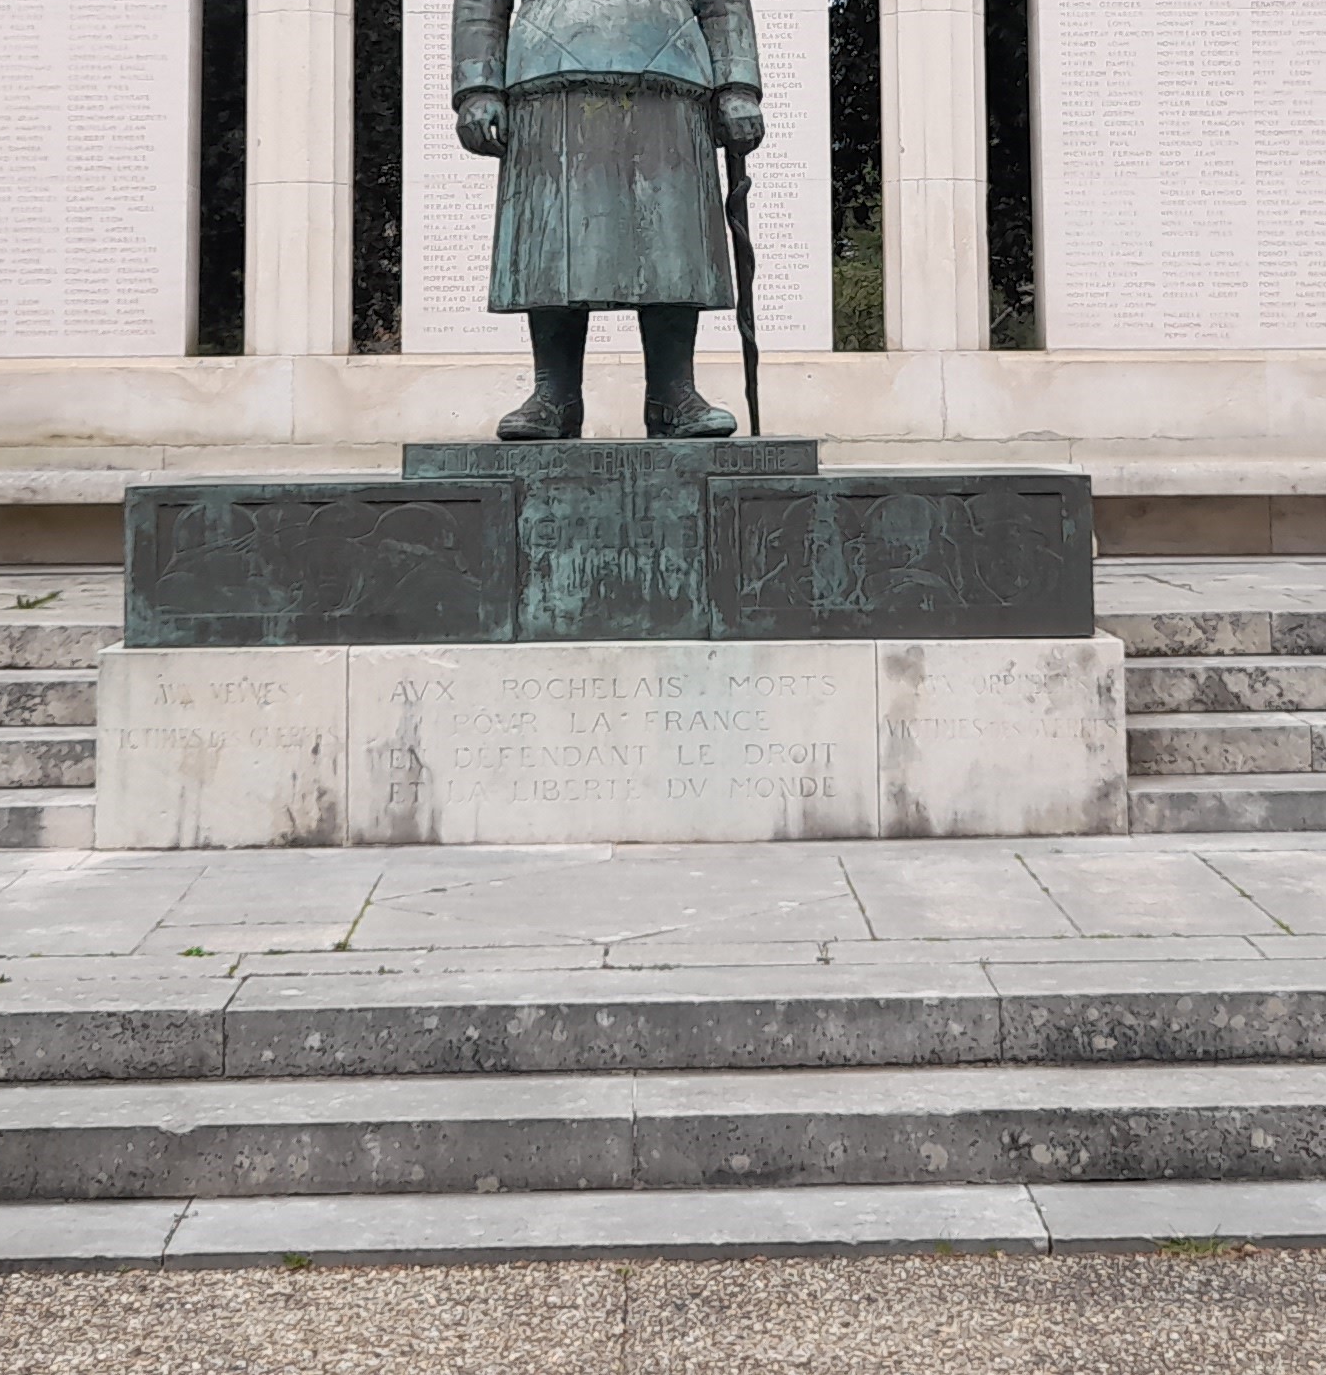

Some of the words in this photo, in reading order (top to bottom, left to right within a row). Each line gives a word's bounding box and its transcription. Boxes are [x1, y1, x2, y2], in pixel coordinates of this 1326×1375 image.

[389, 679, 455, 703] AVX
[501, 676, 682, 699] ROCHELAIS
[728, 675, 837, 697] MORTS
[453, 710, 538, 736] POVR
[570, 712, 611, 734] LA
[644, 710, 770, 732] FRANCE
[677, 745, 715, 767] LE
[743, 742, 836, 767] DROIT
[388, 781, 424, 805] ET
[446, 779, 490, 803] LA
[666, 777, 707, 800] DV
[728, 777, 837, 800] MONDE
